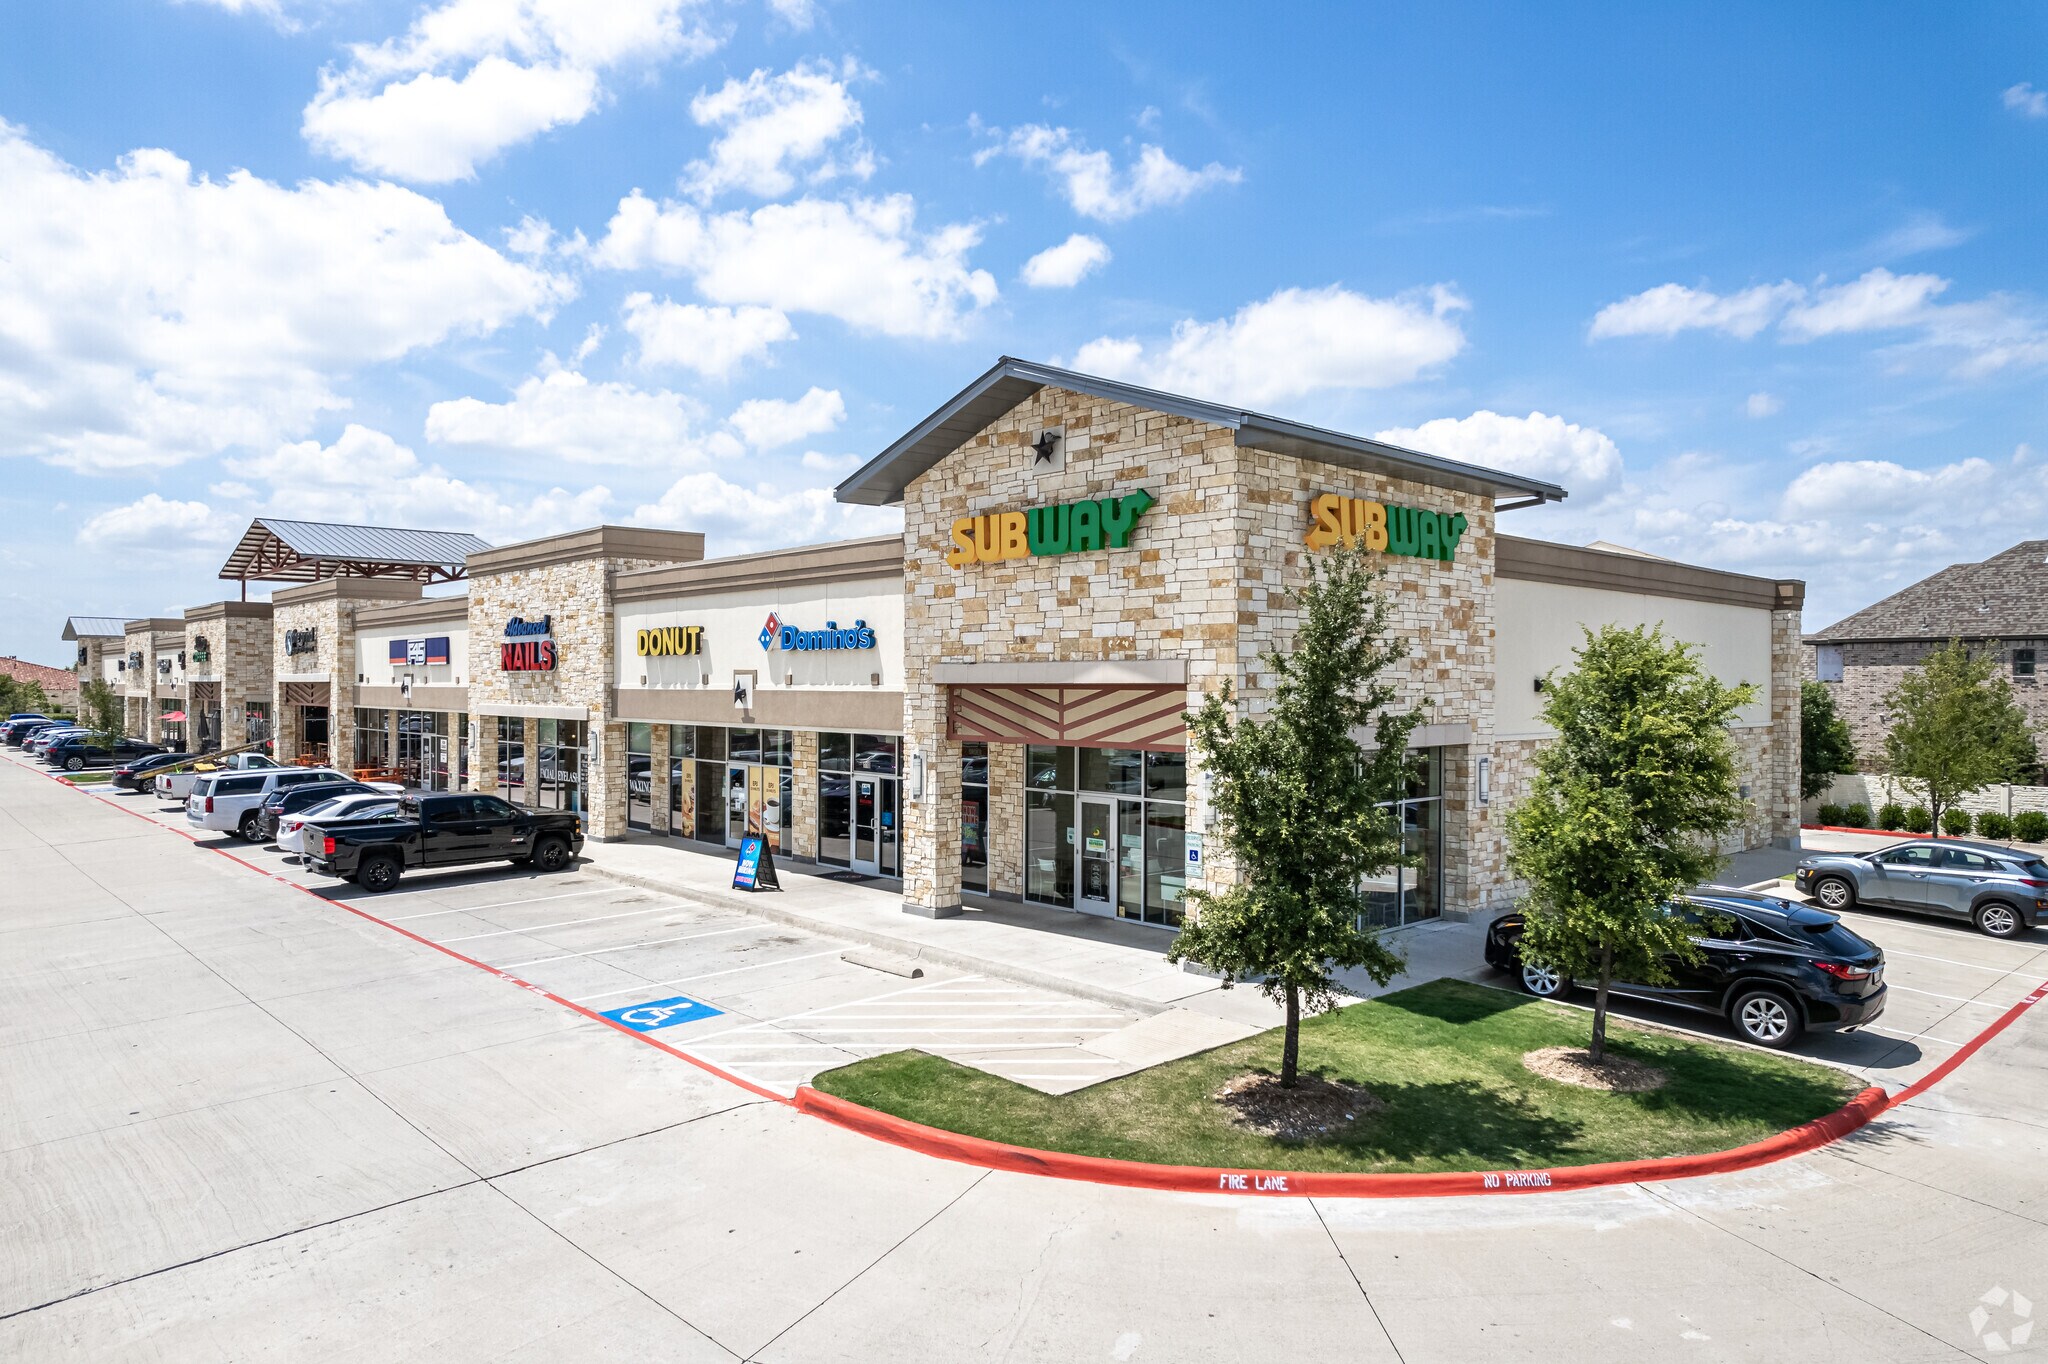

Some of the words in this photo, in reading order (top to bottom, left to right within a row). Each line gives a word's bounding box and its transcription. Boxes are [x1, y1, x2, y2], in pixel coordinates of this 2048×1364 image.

[946, 488, 1154, 570] SUBWAY
[1304, 493, 1468, 561] SUBWAY
[504, 615, 551, 637] Advanced
[637, 626, 704, 656] DONUT
[781, 619, 877, 651] Domino's
[501, 640, 558, 671] NAILS
[1219, 1174, 1249, 1190] FIRE
[1255, 1175, 1289, 1192] LANE
[1483, 1173, 1500, 1188] NO
[1504, 1172, 1552, 1188] PARKING
